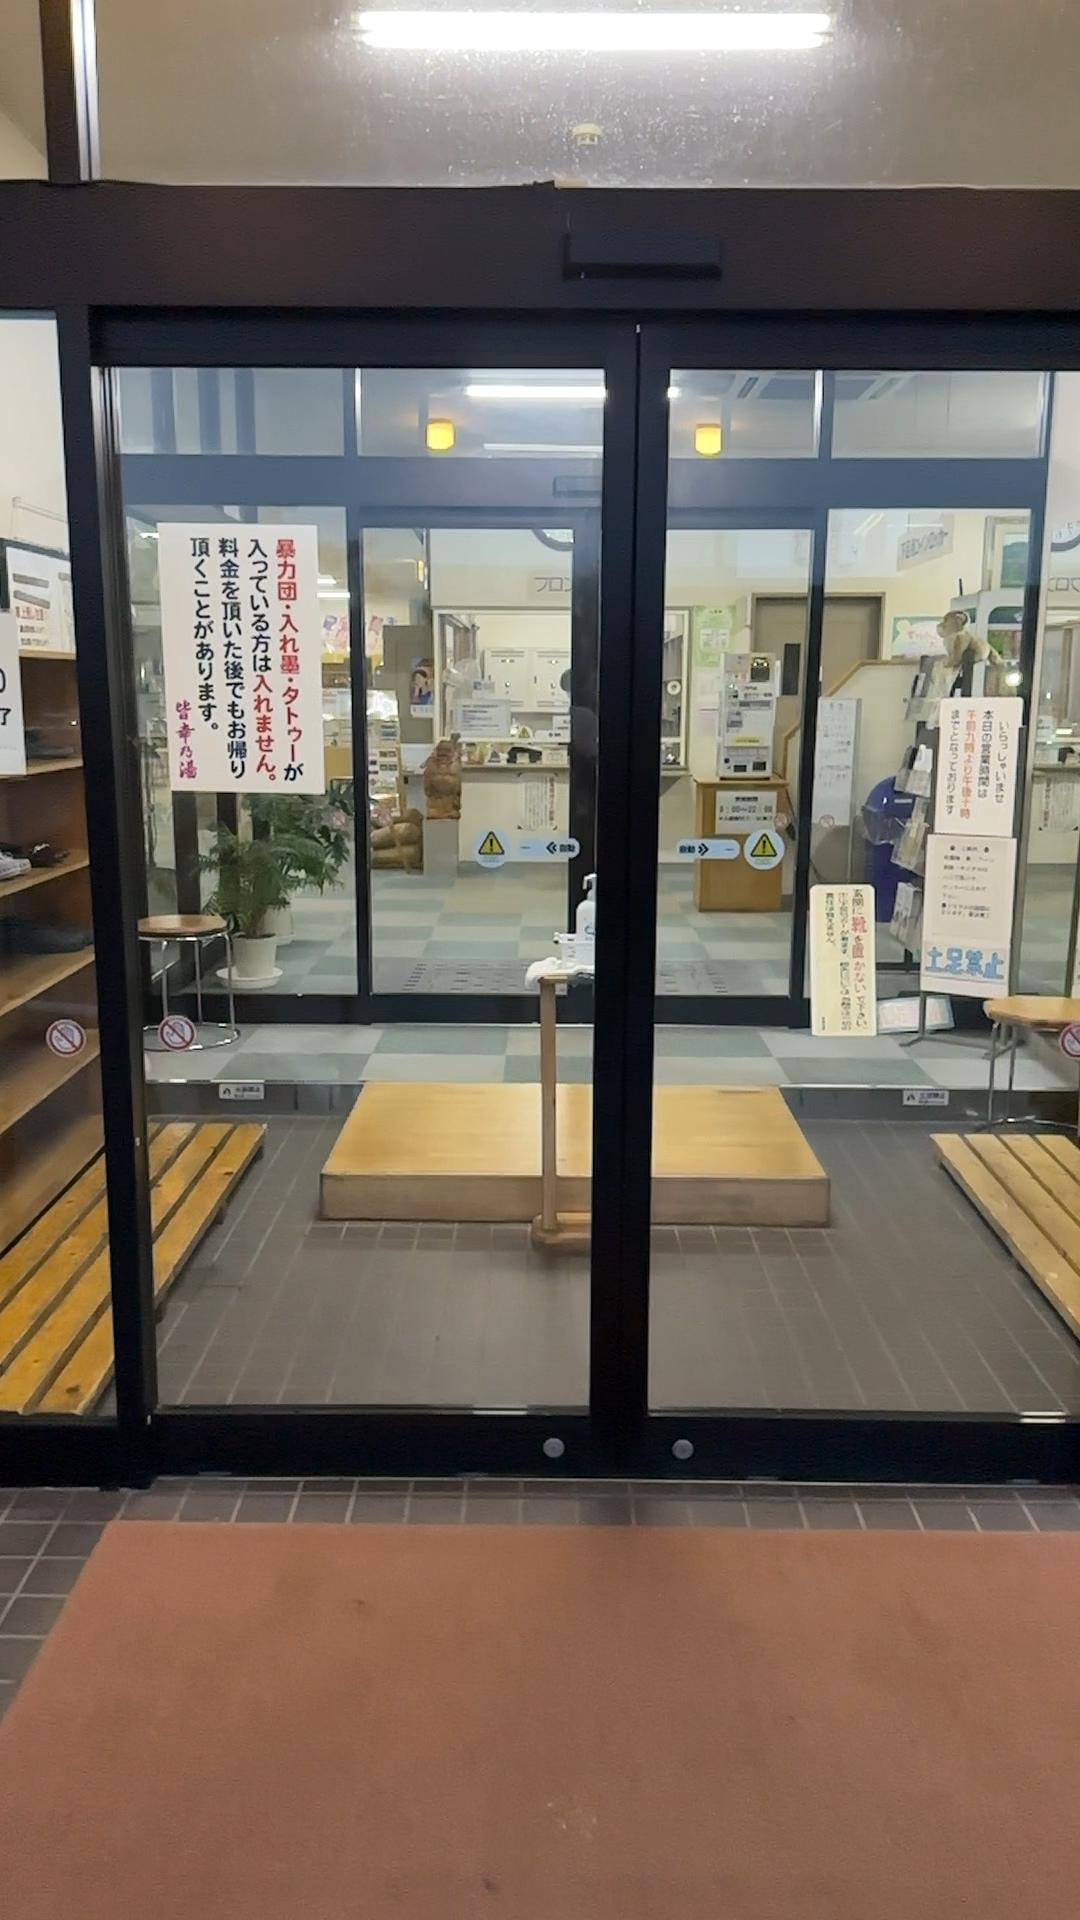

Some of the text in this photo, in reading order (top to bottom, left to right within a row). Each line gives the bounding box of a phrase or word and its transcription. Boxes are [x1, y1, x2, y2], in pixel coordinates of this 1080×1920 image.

[190, 538, 219, 730] 頂くことがあります。
[218, 538, 247, 778] 料金を頂いた後でもお帰り
[248, 539, 277, 782] 入っている方は入れません。
[978, 710, 995, 798] 本日の営業時間は
[925, 946, 1004, 979] 土足禁止
